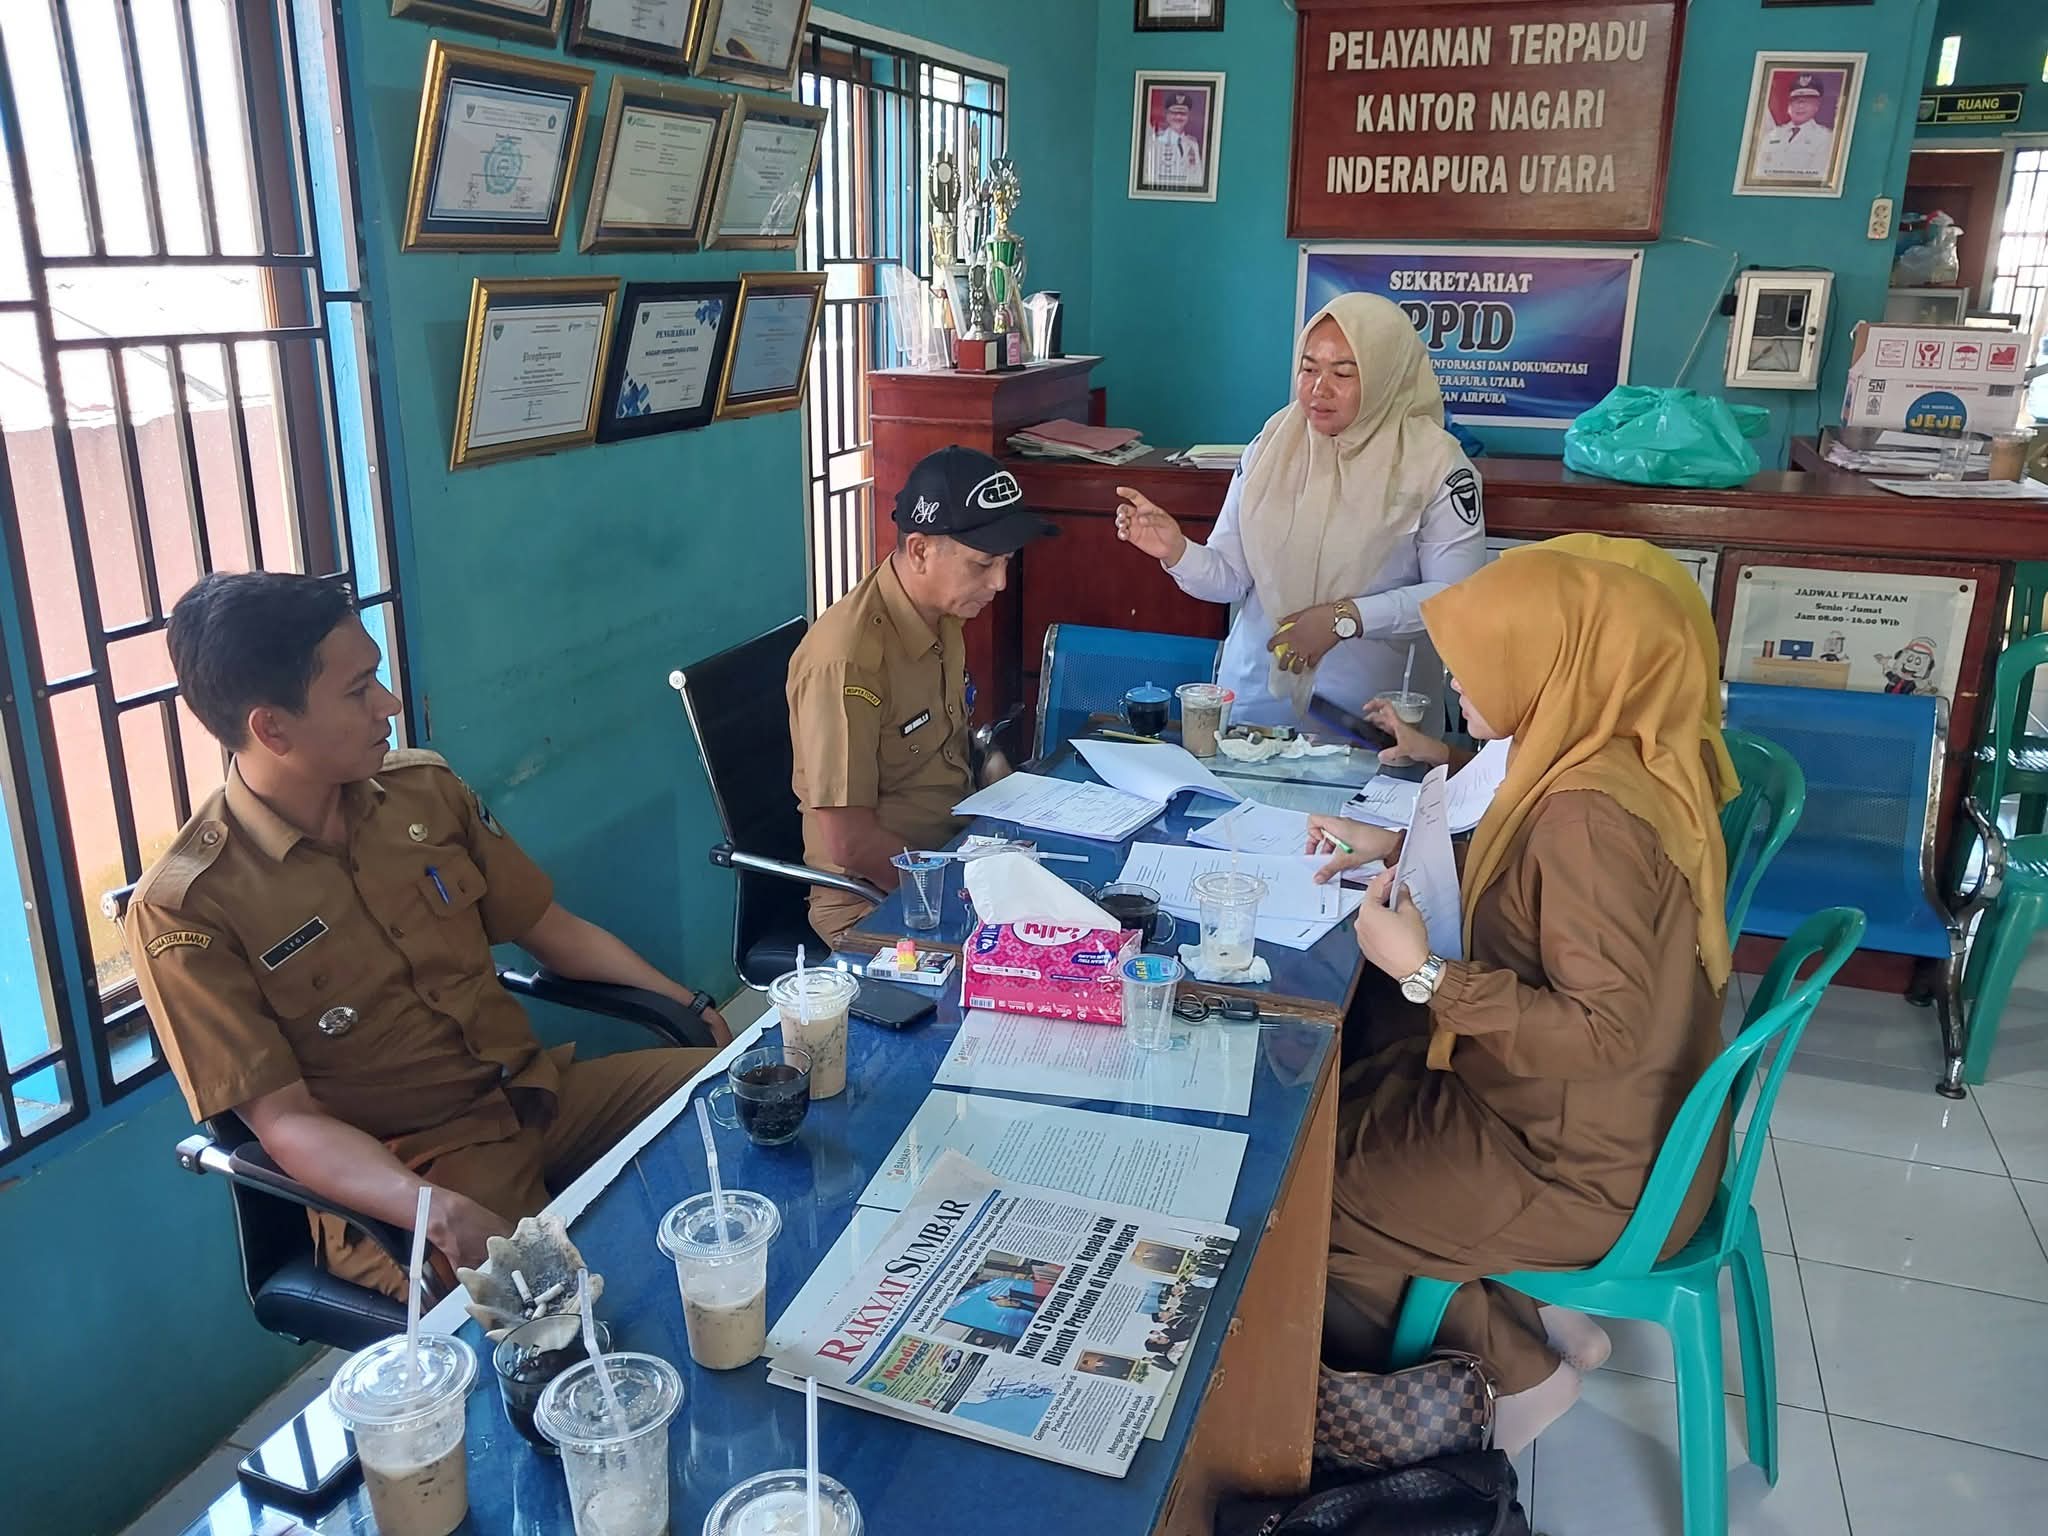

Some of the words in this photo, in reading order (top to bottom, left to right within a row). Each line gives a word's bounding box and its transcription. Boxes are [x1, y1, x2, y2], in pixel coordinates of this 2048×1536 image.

[1327, 26, 1491, 71] PELAYANAN
[1509, 20, 1648, 65] TERPADU
[1356, 92, 1475, 132] KANTOR
[1489, 89, 1605, 132] NAGARI
[1957, 98, 1999, 110] RUANG
[1326, 155, 1508, 194] INDERAPURA
[1519, 154, 1615, 193] UTARA
[1389, 270, 1533, 293] SEKRETARIAT
[1400, 300, 1517, 352] PPID
[1431, 359, 1487, 371] INFORMASI
[1488, 361, 1512, 372] DAN
[1512, 361, 1589, 375] DOKUMENTASI
[1490, 376, 1526, 388] UTARA
[1460, 391, 1507, 404] AIRPURA
[1868, 379, 1886, 393] SNI
[1910, 413, 1963, 430] JEJE
[1794, 588, 1840, 598] JADWAL
[1842, 591, 1909, 603] PELAYANAN
[1815, 602, 1843, 611] Senin
[1850, 604, 1883, 614] Jumat
[1794, 612, 1816, 620] Jam
[1818, 614, 1844, 622] 08.00
[149, 933, 183, 954] SUMATERA
[184, 933, 210, 946] BARAT
[1091, 1215, 1117, 1235] BGN
[1107, 1221, 1141, 1253] Negara
[1074, 1232, 1108, 1263] Kepala
[910, 1303, 931, 1323] Wako
[924, 1284, 944, 1304] Hendri
[949, 1253, 967, 1270] Buka
[961, 1238, 978, 1254] Pintu
[972, 1214, 996, 1239] Investasi
[917, 1311, 939, 1333] Padang
[932, 1291, 953, 1312] Panjang
[958, 1258, 977, 1277] Percaya
[971, 1250, 982, 1259] Diri
[980, 1223, 1002, 1246] Panggung
[1057, 1262, 1088, 1291] Resmi
[1092, 1250, 1122, 1280] Istana
[815, 1278, 910, 1364] RAKYAT
[884, 1199, 970, 1278] SUMBAR
[875, 1317, 894, 1336] Suara
[891, 1292, 913, 1315] Nurani
[939, 1231, 959, 1253] Madani
[1086, 1277, 1107, 1289] di
[1037, 1289, 1074, 1324] Deyang
[1063, 1287, 1102, 1329] Presiden
[1033, 1322, 1052, 1332] S
[882, 1340, 922, 1380] Mandiri
[1015, 1329, 1047, 1360] Nanik
[1040, 1326, 1079, 1367] Dilantik
[1032, 1419, 1052, 1441] Gempa
[1049, 1395, 1065, 1412] Skala
[1058, 1379, 1075, 1397] Terjadi
[1050, 1409, 1070, 1433] Padang
[1062, 1386, 1082, 1411] Pariaman
[1106, 1427, 1128, 1455] Mengapa
[1119, 1410, 1136, 1429] Warga
[1128, 1394, 1143, 1411] Lubuk
[1116, 1442, 1133, 1461] Ulang
[1131, 1412, 1146, 1430] Minta
[1139, 1394, 1155, 1414] Pindah
